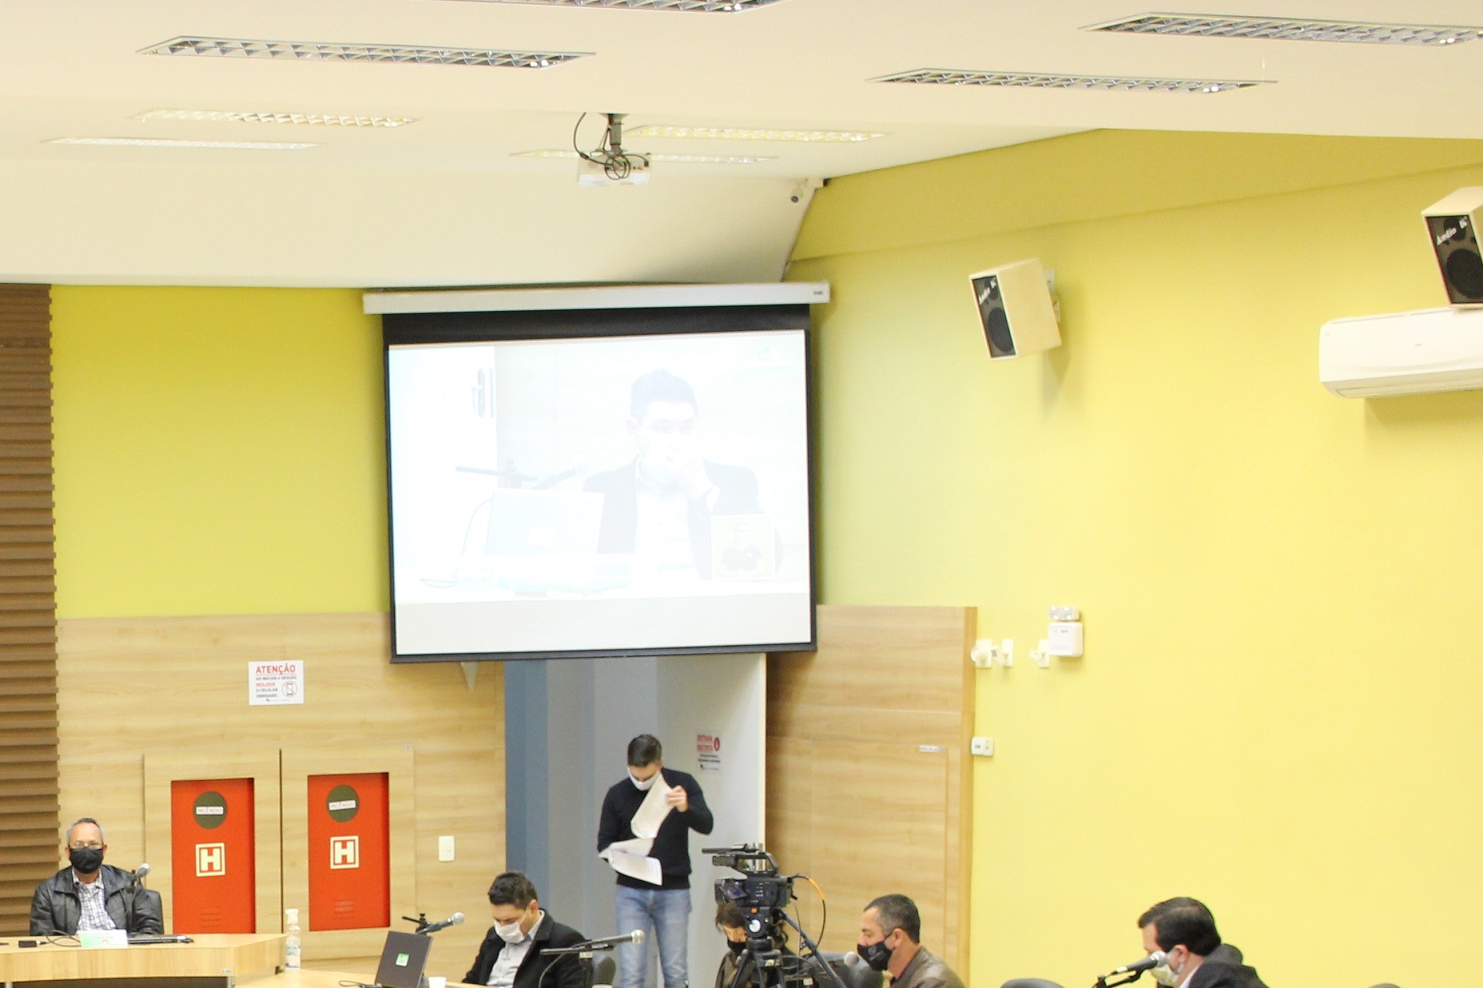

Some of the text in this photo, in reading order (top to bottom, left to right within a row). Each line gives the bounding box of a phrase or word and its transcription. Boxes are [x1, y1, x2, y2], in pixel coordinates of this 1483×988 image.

[256, 663, 296, 675] ATENÇÃO
[201, 848, 221, 872] H
[335, 841, 354, 864] H
